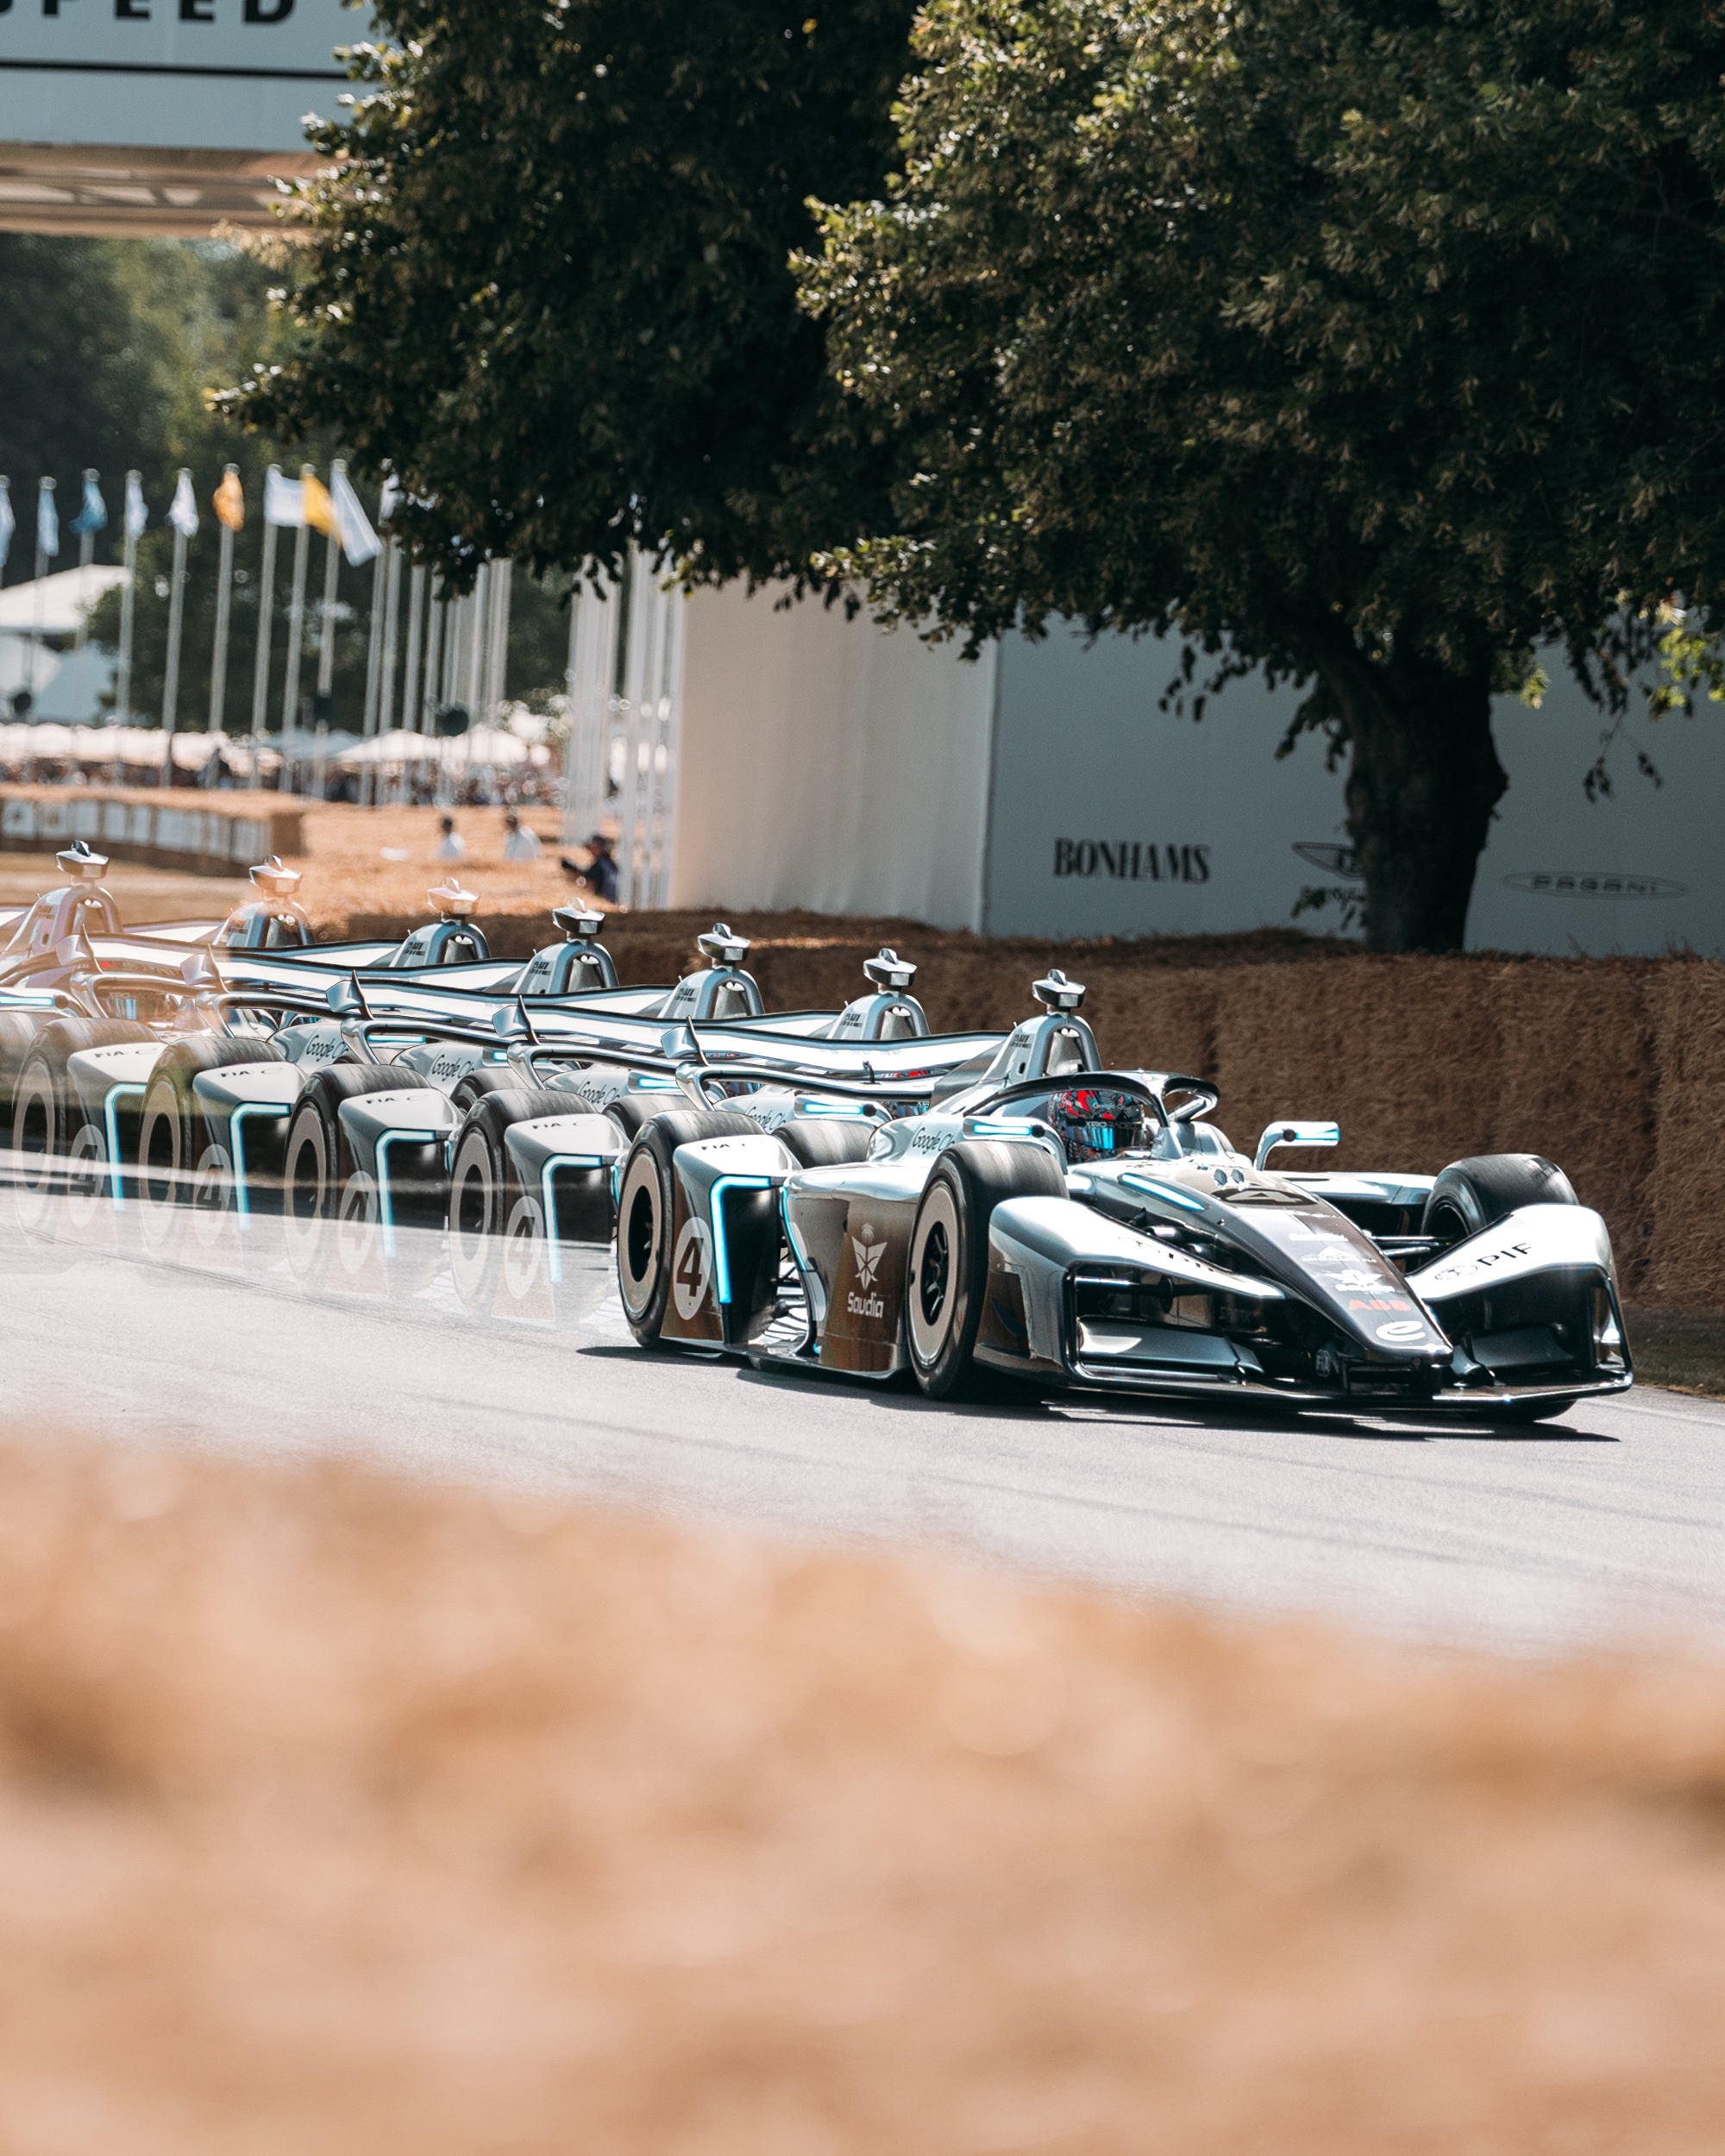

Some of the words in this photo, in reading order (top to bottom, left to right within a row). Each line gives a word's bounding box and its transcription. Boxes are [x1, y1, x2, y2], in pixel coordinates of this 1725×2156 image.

[1054, 837, 1210, 884] BONHAMS
[341, 1190, 370, 1250] 4
[506, 1216, 536, 1275] 4
[676, 1236, 705, 1297] 4
[1476, 1242, 1531, 1267] PIF
